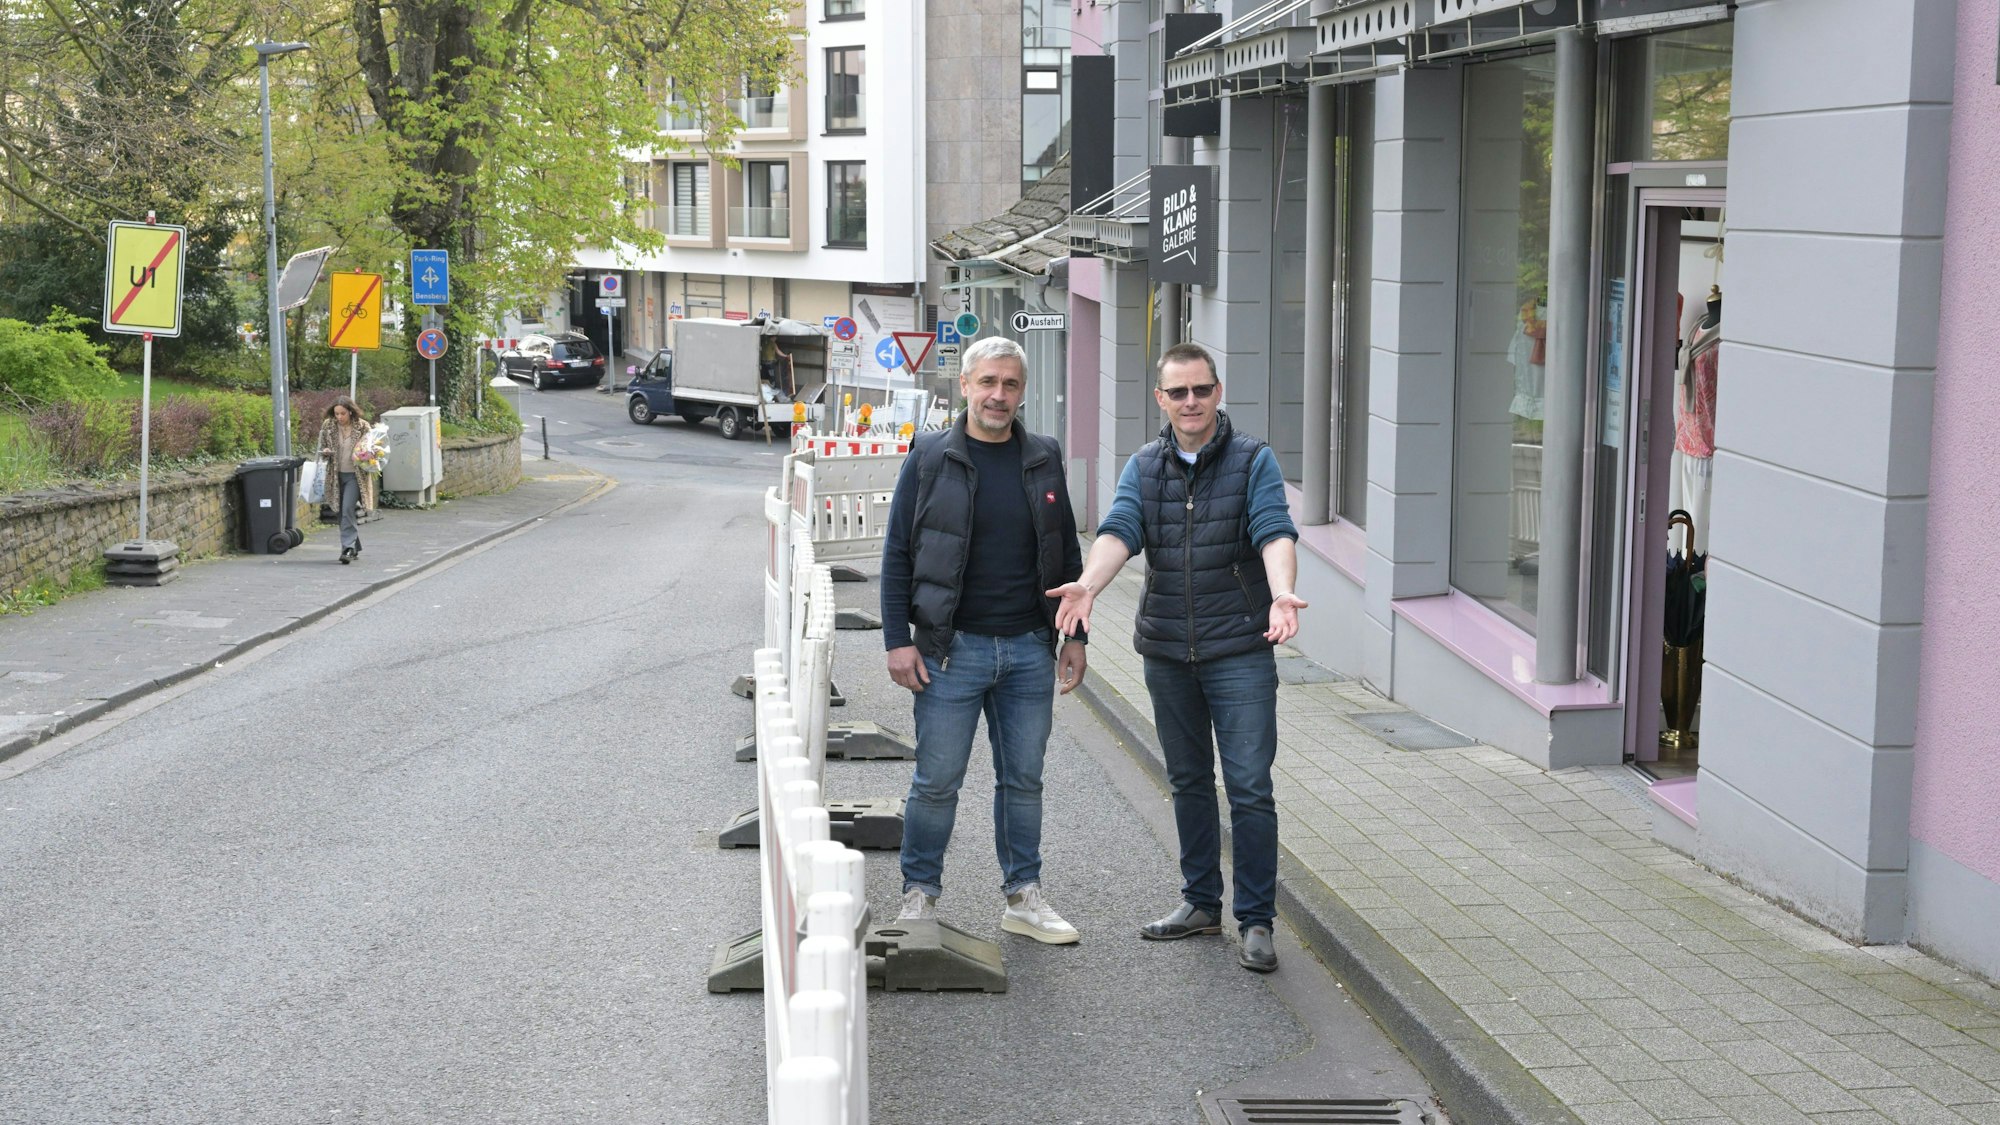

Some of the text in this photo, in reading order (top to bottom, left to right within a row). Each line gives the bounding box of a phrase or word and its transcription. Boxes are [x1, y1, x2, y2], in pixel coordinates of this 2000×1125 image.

[1164, 184, 1197, 216] BILD &
[1163, 205, 1197, 236] KLANG
[1163, 225, 1197, 253] GALERIE
[130, 266, 156, 288] U1
[415, 292, 447, 301] Bensberg
[670, 302, 682, 314] dm
[1030, 317, 1062, 327] Ausfahrt
[942, 324, 956, 343] P
